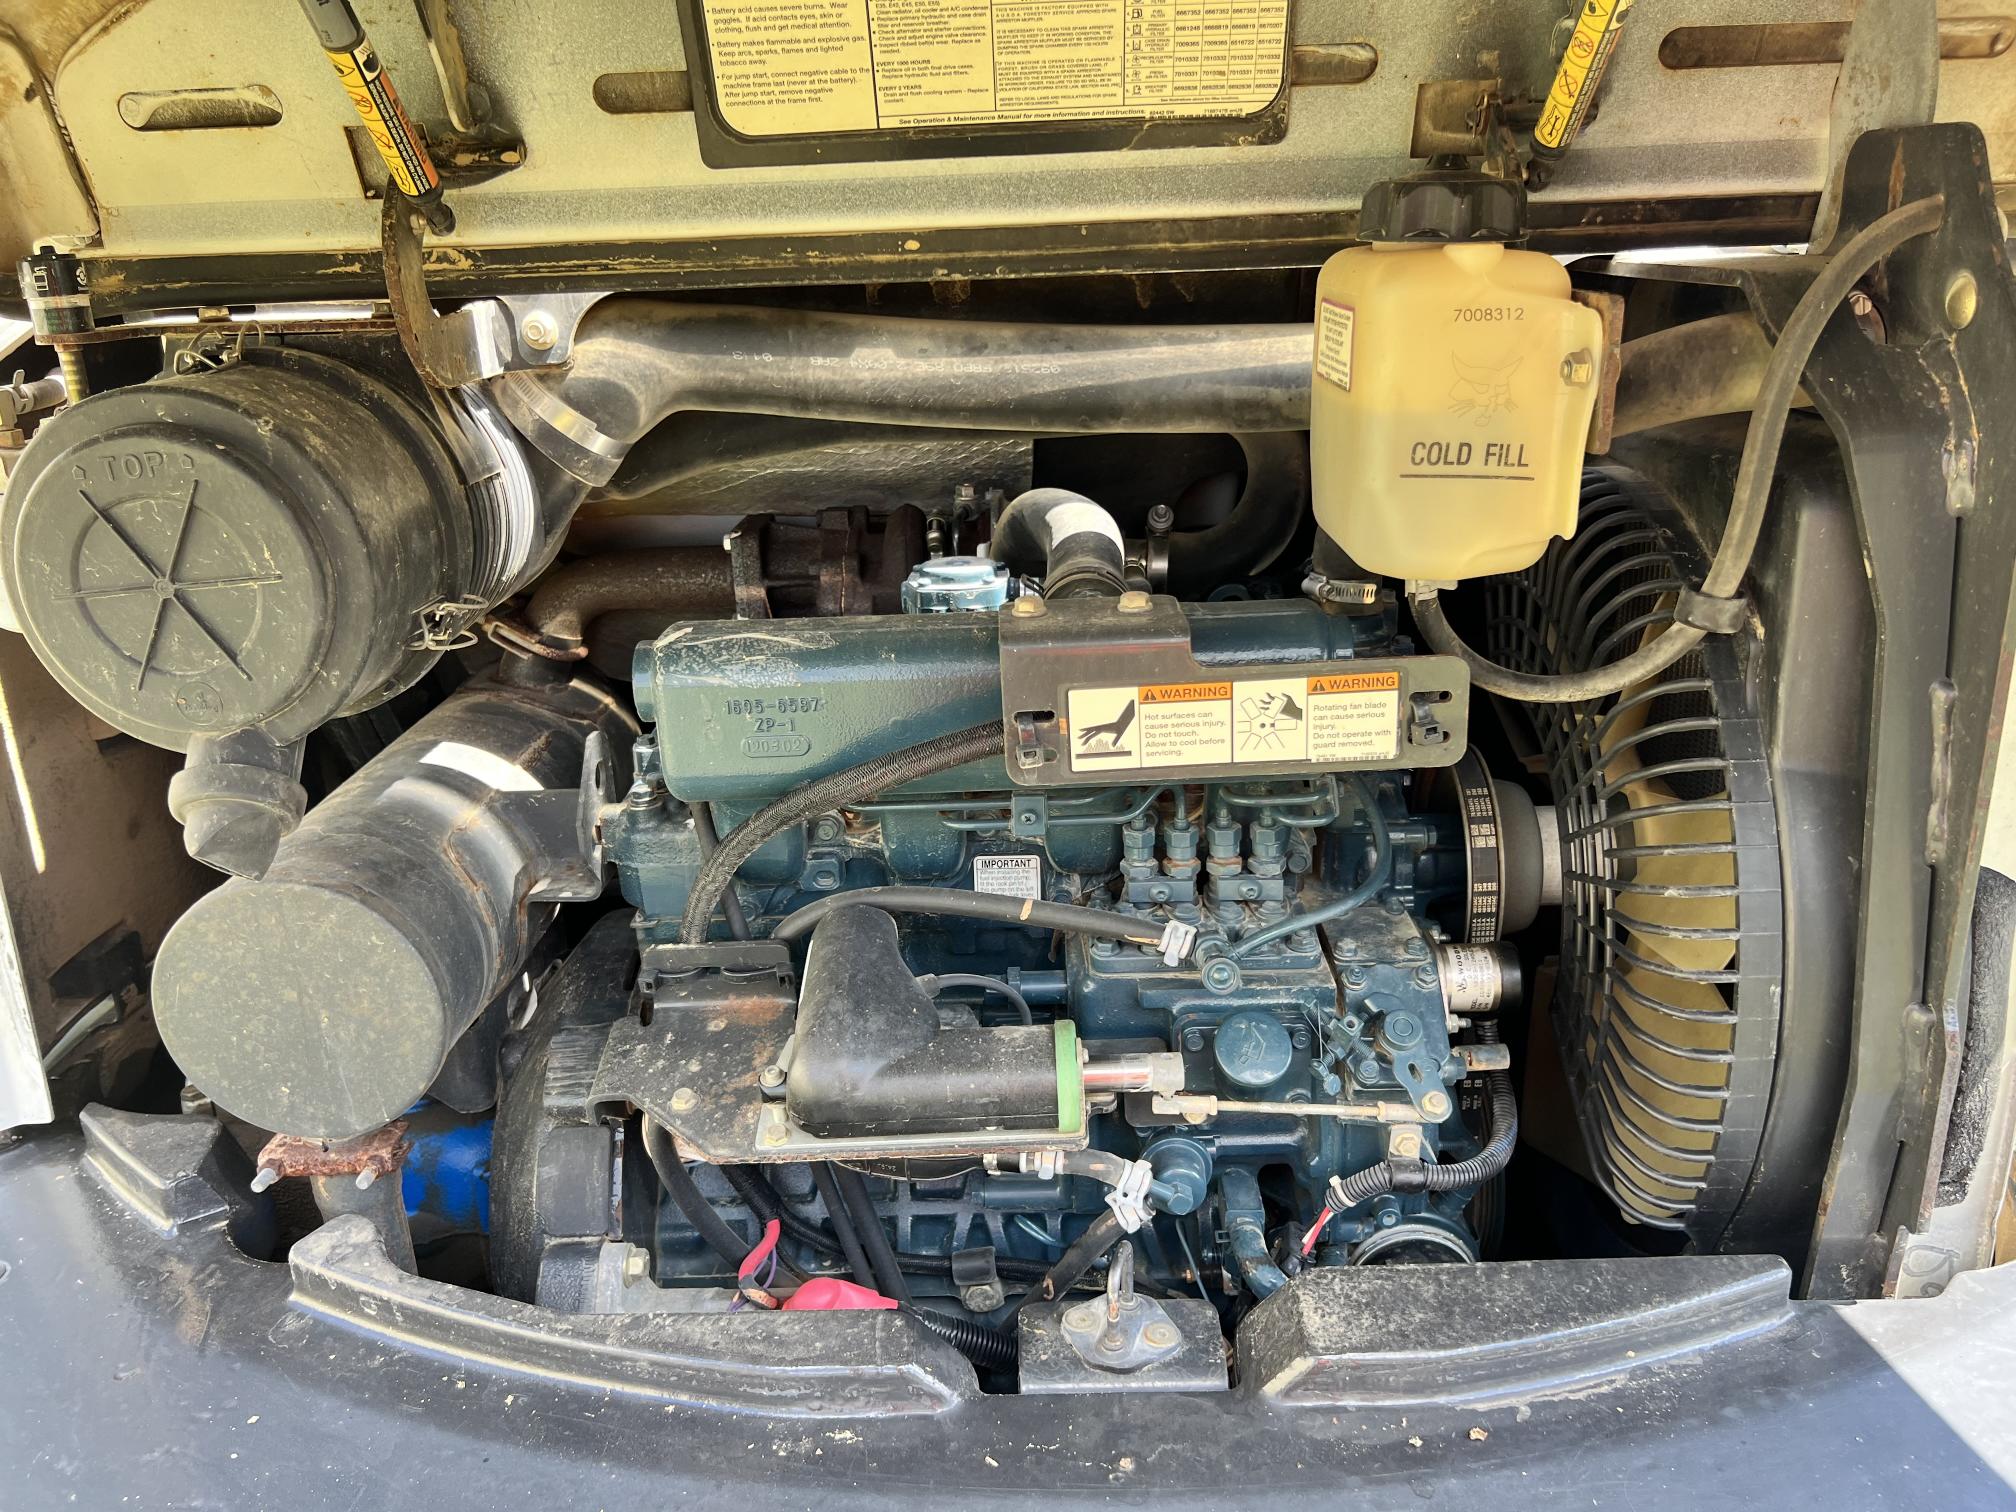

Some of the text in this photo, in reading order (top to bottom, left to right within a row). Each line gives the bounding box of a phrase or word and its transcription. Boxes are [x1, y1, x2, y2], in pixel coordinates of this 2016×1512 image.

[712, 7, 736, 17] Battery
[829, 2, 848, 10] Wear
[768, 14, 798, 22] contacts
[778, 23, 789, 33] get
[791, 22, 818, 30] medical
[717, 40, 740, 50] Battery
[742, 39, 764, 47] makes
[766, 38, 802, 46] flammable
[818, 36, 850, 46] explosive
[718, 50, 736, 59] Keep
[781, 47, 804, 55] flames
[820, 45, 844, 55] lighted
[771, 70, 798, 79] connect
[800, 69, 828, 79] negative
[723, 81, 751, 89] machine
[787, 79, 807, 89] (never
[805, 86, 834, 96] negative
[726, 98, 766, 107] connections
[1454, 308, 1524, 322] 7008312
[1410, 442, 1529, 468] COLD FILL
[98, 452, 164, 480] TOP
[1330, 676, 1395, 689] WARNING
[1160, 686, 1228, 699] WARNING
[1314, 704, 1347, 713] Rotating
[755, 718, 796, 732] ZP-1
[1342, 730, 1373, 739] operate
[1313, 741, 1336, 749] guard
[982, 860, 1031, 868] IMPORTANT
